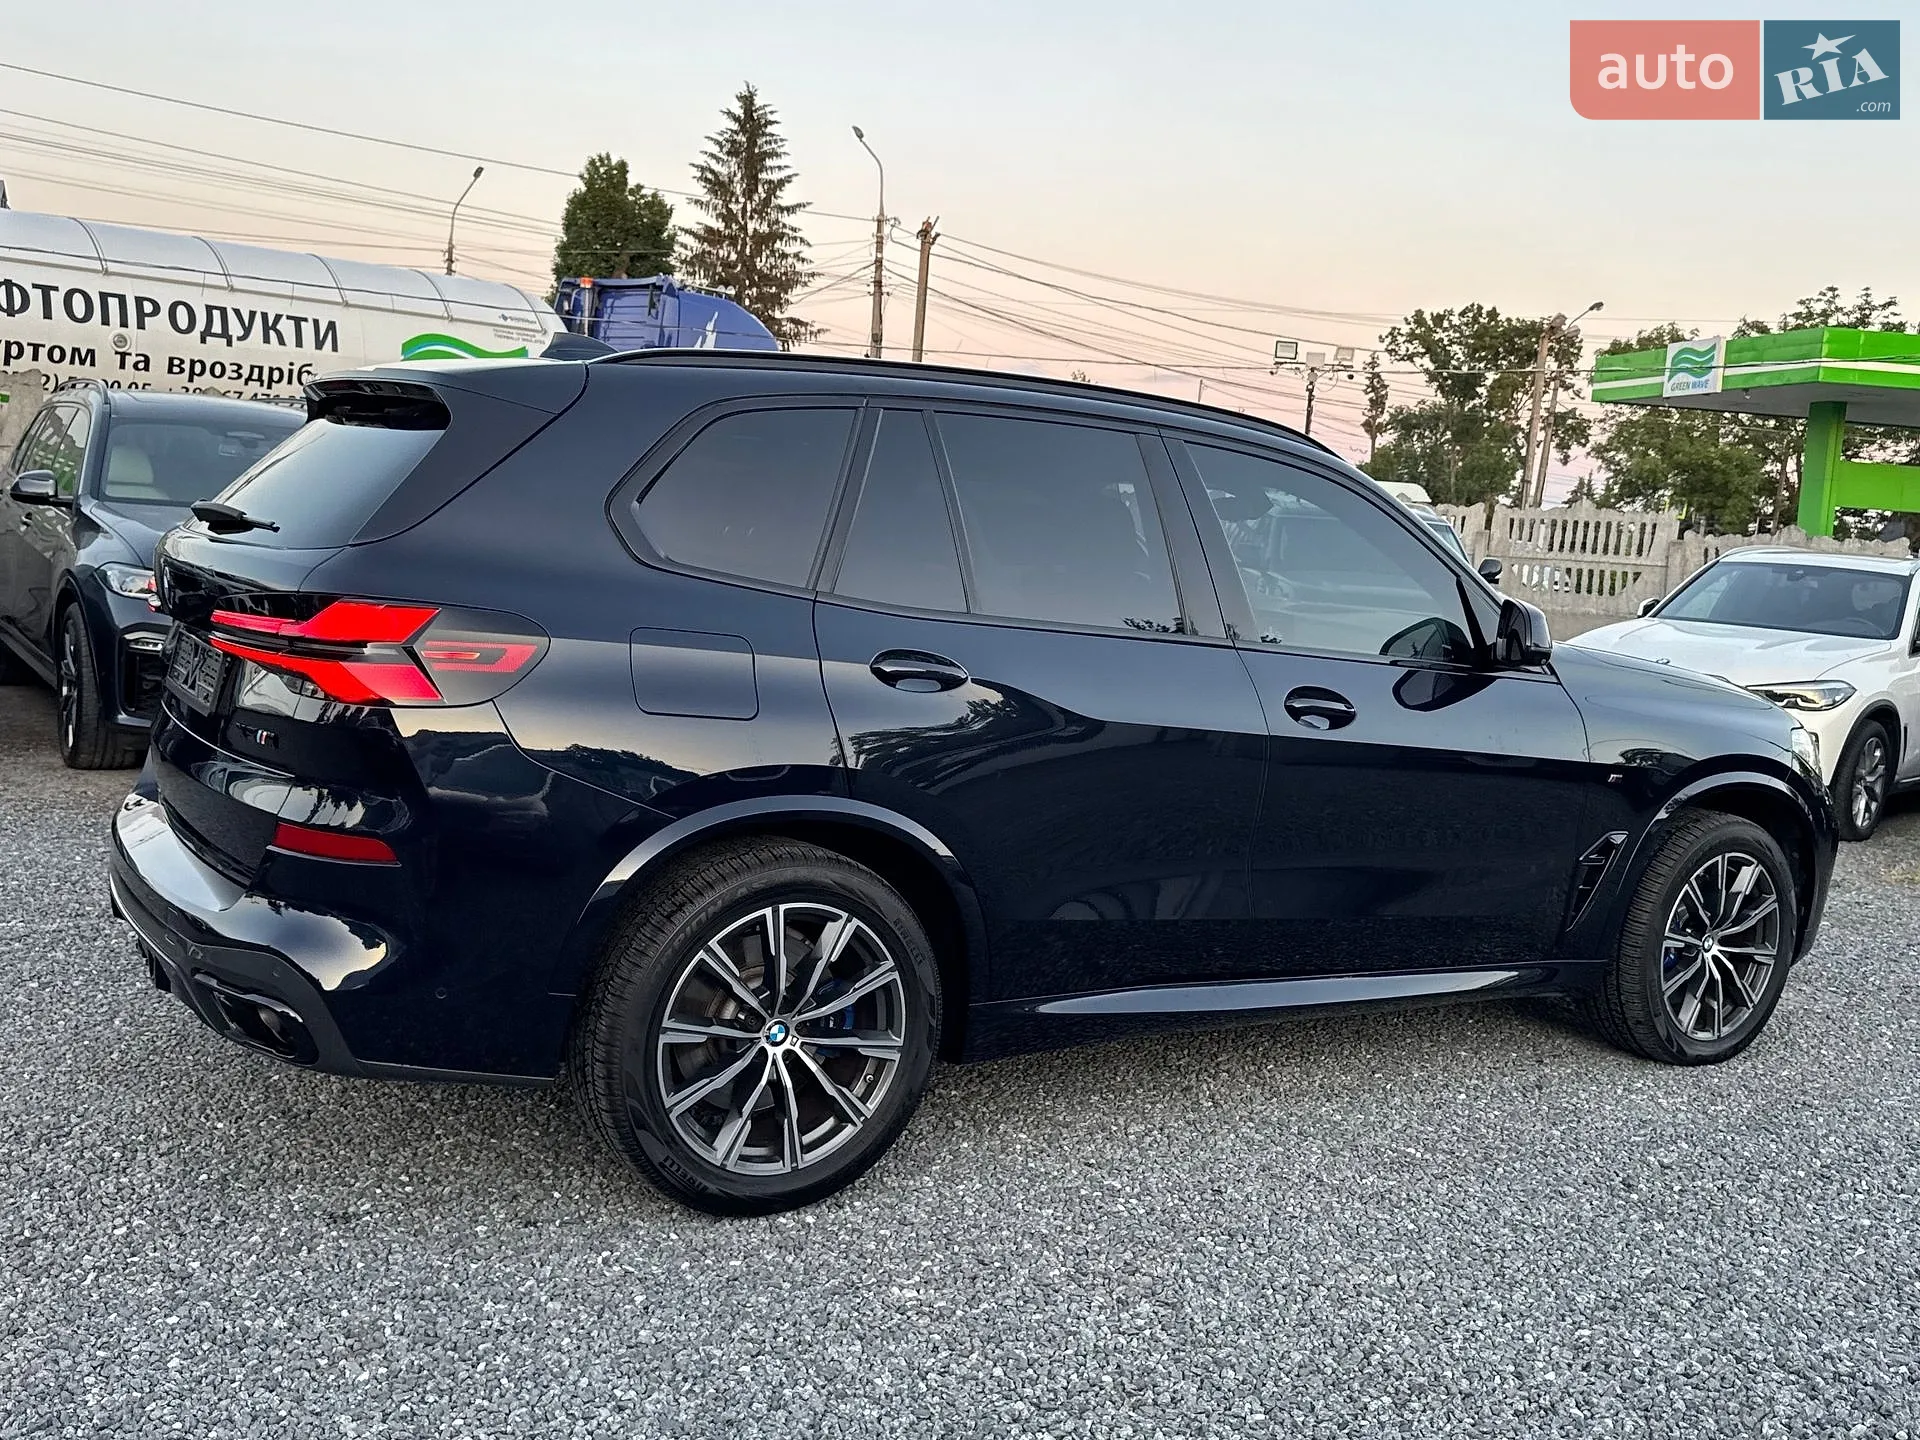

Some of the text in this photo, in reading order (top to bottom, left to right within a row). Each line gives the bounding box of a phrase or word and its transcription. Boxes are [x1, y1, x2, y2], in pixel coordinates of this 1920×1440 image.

[0, 278, 339, 353] ФТОПРОДУКТИ
[0, 338, 97, 368] ртом
[114, 350, 151, 373] та
[1670, 379, 1710, 392] GREEN WAVE
